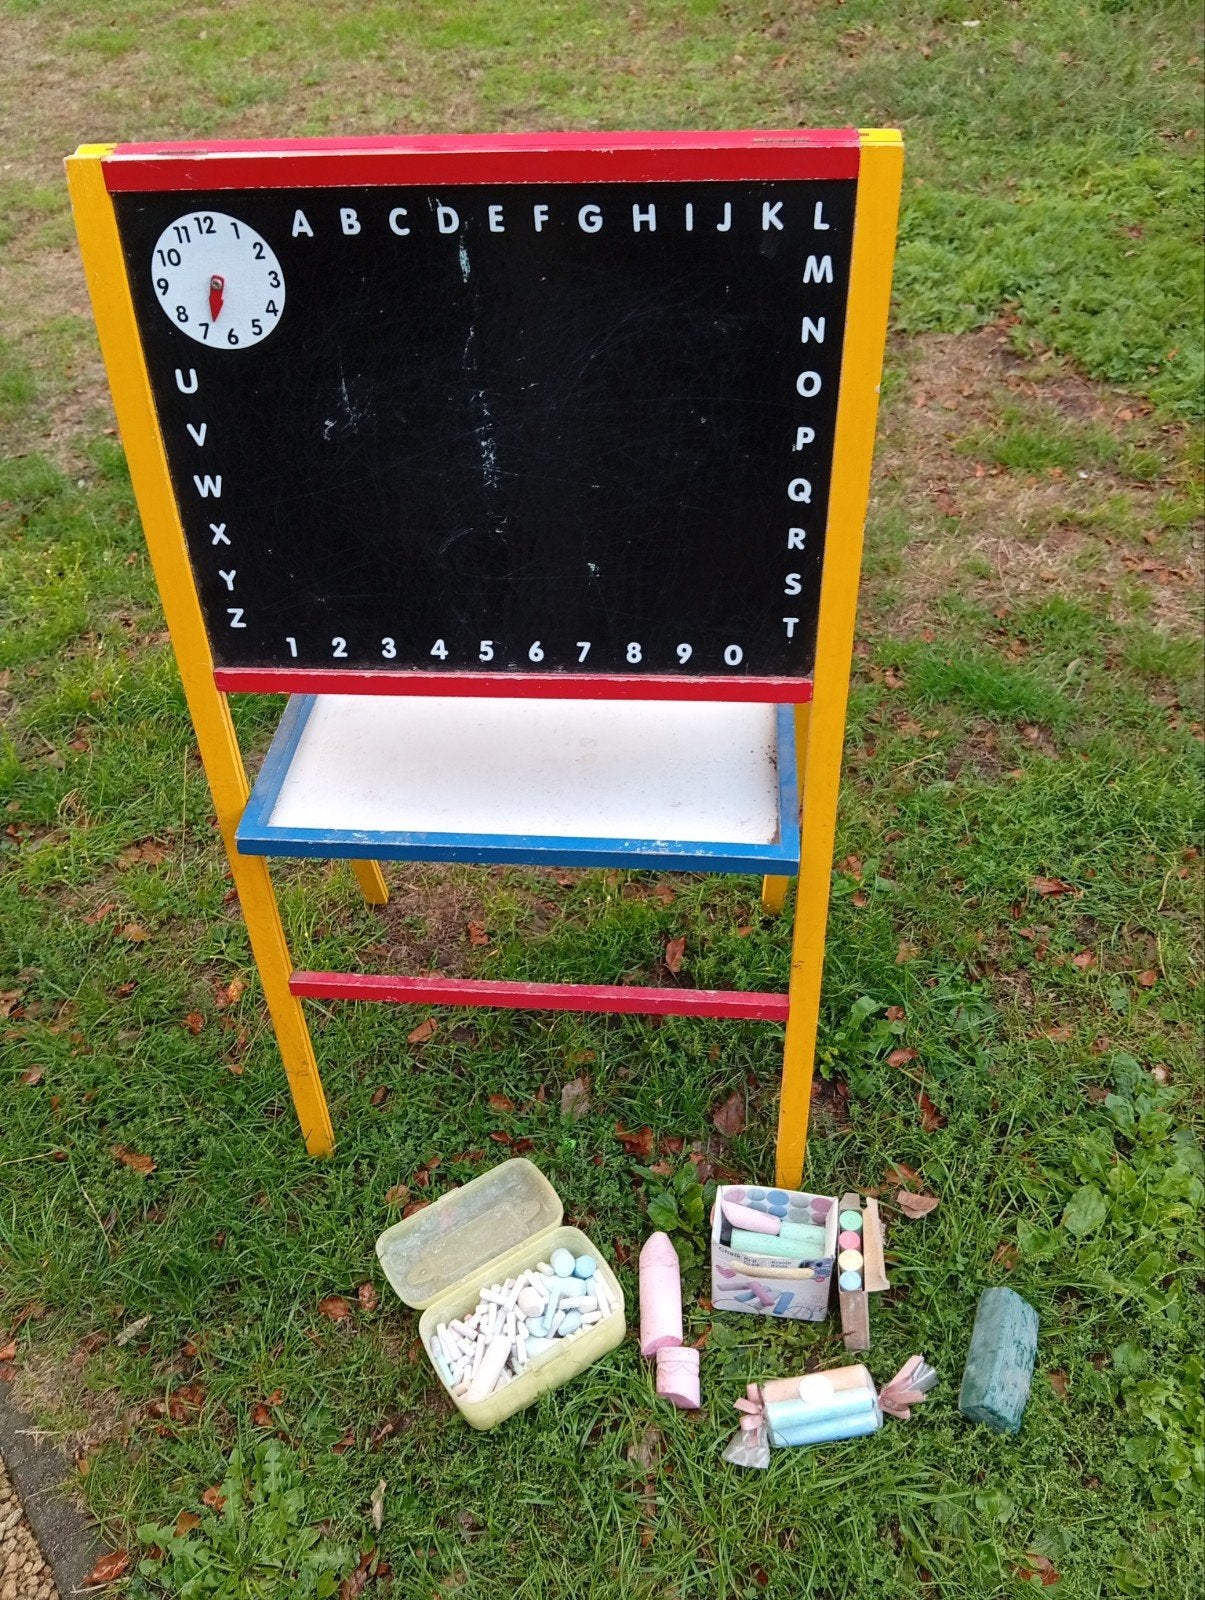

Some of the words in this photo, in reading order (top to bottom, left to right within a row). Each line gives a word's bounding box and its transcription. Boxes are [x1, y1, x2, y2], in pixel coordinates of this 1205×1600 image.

[193, 215, 217, 235] 12
[229, 221, 241, 240] 1
[291, 209, 314, 238] A
[339, 207, 361, 235] B
[388, 207, 411, 236] C
[436, 205, 460, 235] D
[488, 204, 505, 233] E
[533, 204, 549, 233] F
[578, 204, 603, 234] G
[632, 203, 657, 233] H
[685, 202, 693, 232] I
[716, 201, 732, 232] J
[762, 201, 784, 231] K
[813, 201, 830, 231] L
[172, 225, 192, 244] 11
[156, 247, 182, 268] 10
[252, 241, 266, 261] 2
[267, 270, 281, 289] 3
[802, 254, 834, 284] M
[156, 277, 170, 296] 9
[175, 305, 189, 323] 8
[265, 299, 280, 317] 4
[198, 322, 210, 341] 7
[227, 327, 240, 346] 6
[251, 318, 263, 337] 5
[801, 316, 826, 344] N
[174, 368, 199, 394] U
[796, 370, 822, 398] O
[186, 422, 207, 447] V
[795, 426, 816, 451] P
[193, 474, 222, 498] W
[787, 477, 812, 504] Q
[209, 522, 232, 546] X
[787, 527, 806, 550] R
[218, 569, 237, 591] Y
[784, 572, 802, 596] S
[226, 607, 247, 628] Z
[782, 617, 800, 641] T
[285, 637, 298, 658] 1
[331, 636, 348, 658] 2
[381, 637, 397, 659] 3
[430, 638, 449, 661] 4
[478, 640, 494, 663] 5
[528, 640, 545, 663] 6
[576, 641, 591, 663] 7
[626, 641, 643, 664] 8
[676, 643, 693, 665] 9
[723, 644, 744, 666] 0
[718, 1246, 742, 1260] Chalk
